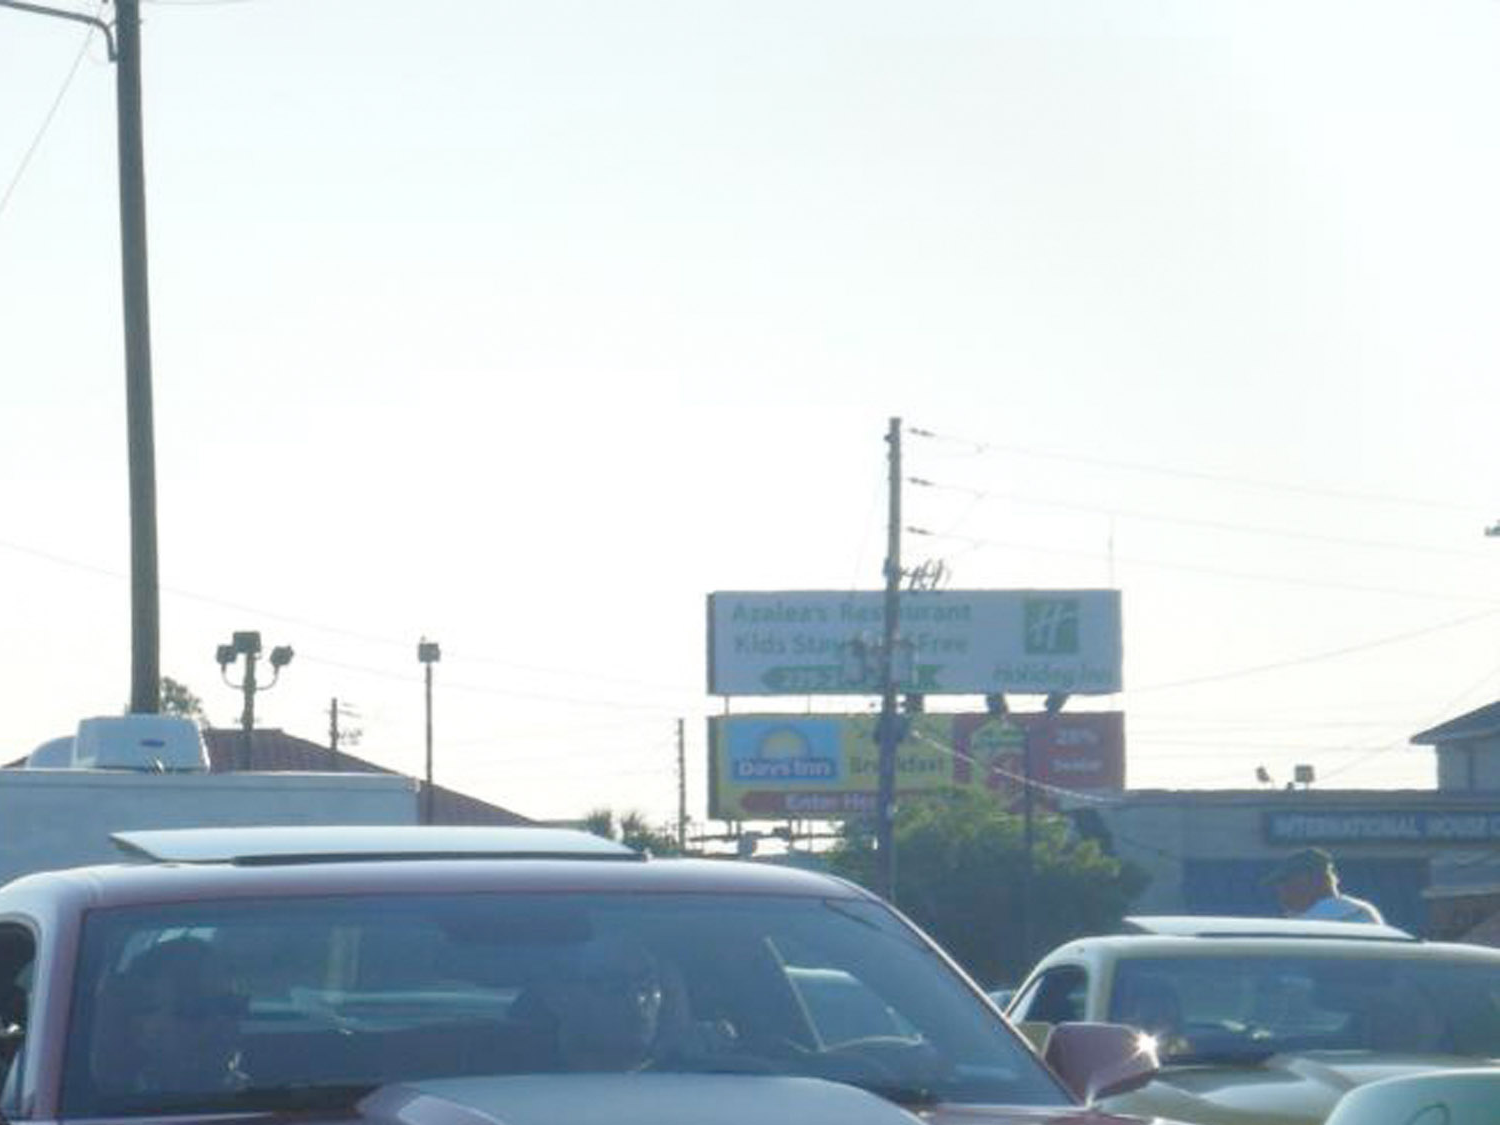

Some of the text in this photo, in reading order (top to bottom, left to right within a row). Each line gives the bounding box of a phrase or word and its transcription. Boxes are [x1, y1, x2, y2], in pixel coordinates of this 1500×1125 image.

[840, 602, 972, 622] Resurant
[737, 761, 791, 778] Days
[1273, 816, 1421, 837] INTERNATIONAL
